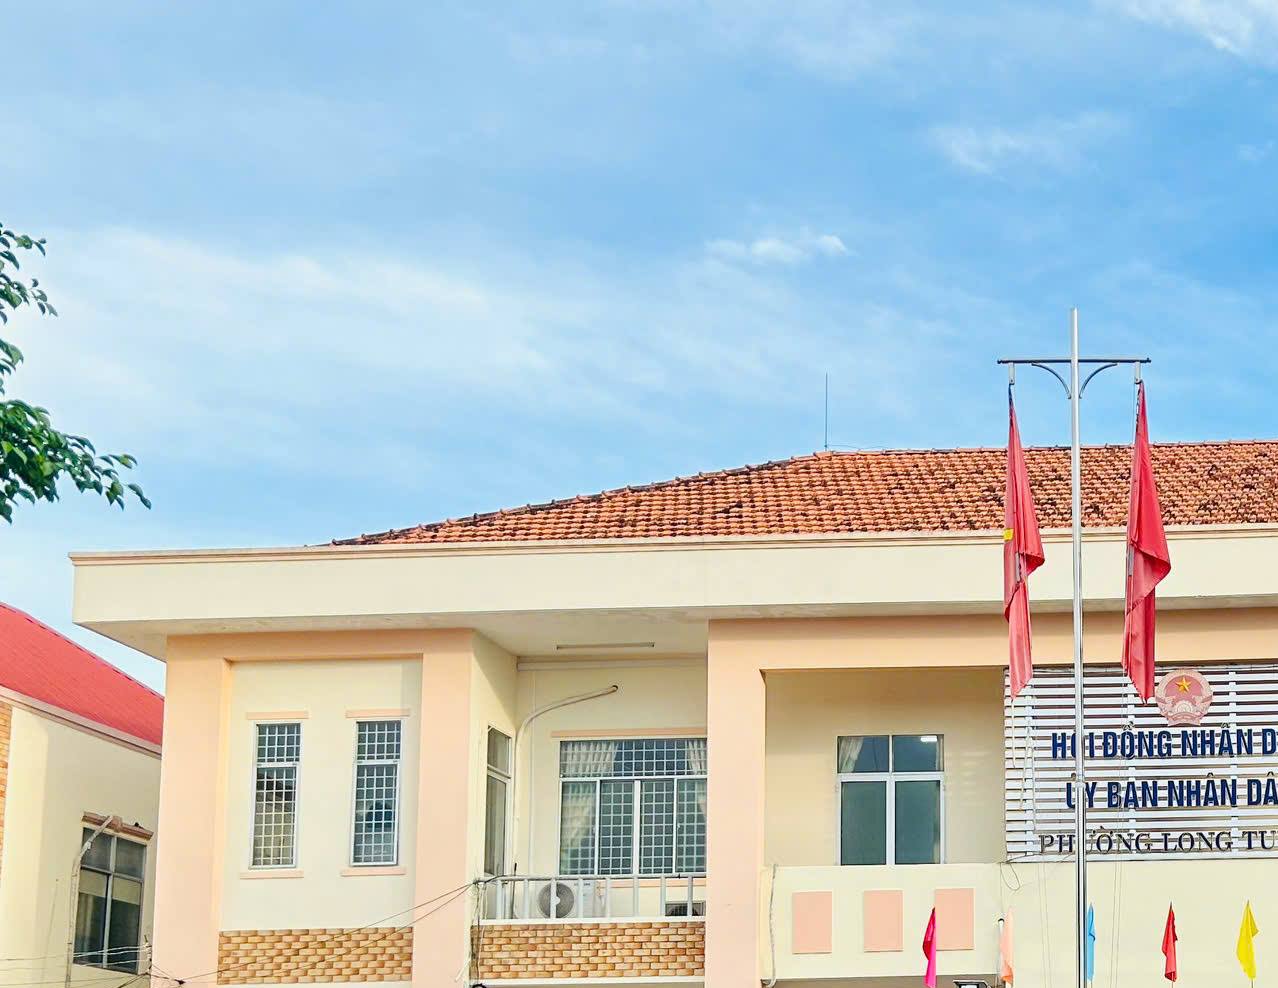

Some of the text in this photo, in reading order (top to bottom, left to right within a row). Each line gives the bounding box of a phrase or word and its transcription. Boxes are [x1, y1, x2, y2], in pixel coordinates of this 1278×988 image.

[1102, 720, 1172, 760] ĐỒNG
[1181, 721, 1253, 756] NHÂN
[1108, 781, 1158, 808] BAN
[1168, 772, 1237, 807] NHÂN
[1161, 831, 1233, 852] LONG
